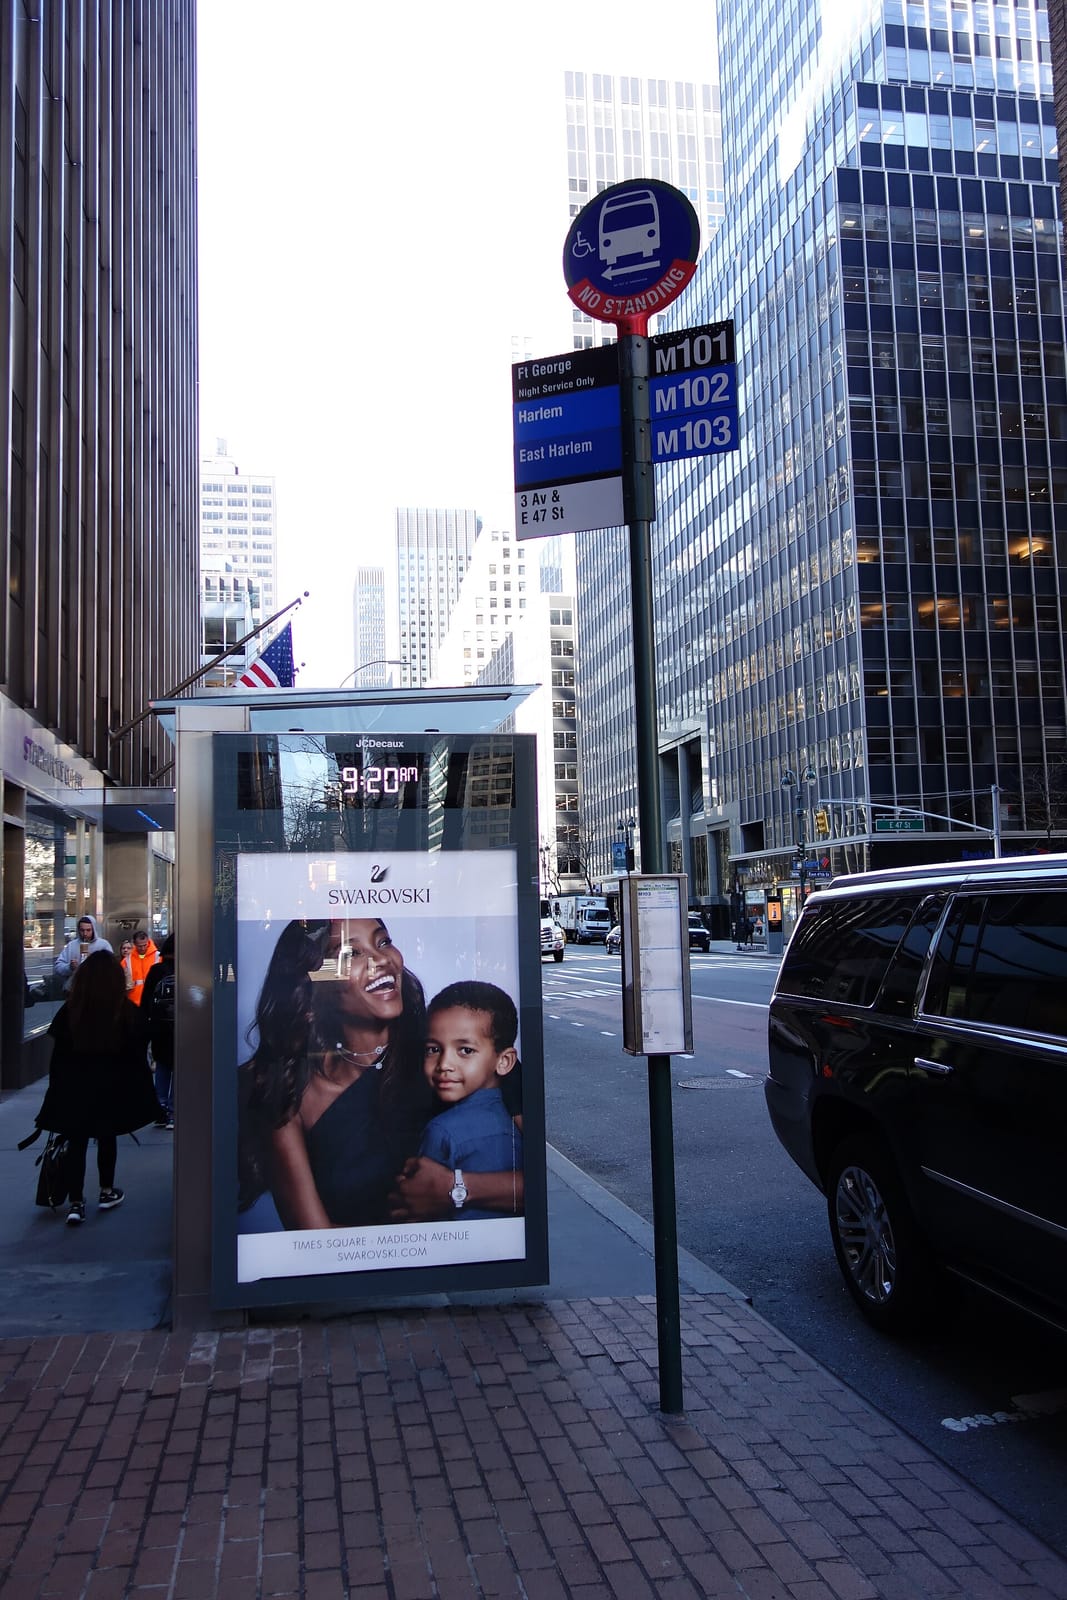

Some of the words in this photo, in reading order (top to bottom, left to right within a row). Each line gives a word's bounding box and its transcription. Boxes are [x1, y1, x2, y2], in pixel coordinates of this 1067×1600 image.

[578, 285, 600, 308] NO
[602, 267, 686, 315] STANDING
[655, 330, 727, 373] M101
[518, 366, 529, 380] Ft
[532, 359, 572, 378] George
[518, 386, 541, 399] Night
[542, 380, 574, 394] Service
[576, 375, 596, 388] Only
[655, 372, 730, 413] M102
[518, 405, 563, 424] Harlem
[657, 415, 732, 456] M103
[519, 450, 545, 463] East
[548, 438, 593, 458] Harlem
[520, 494, 528, 508] 3
[532, 493, 547, 506] Av
[551, 489, 561, 503] &
[521, 511, 529, 525] E
[533, 508, 547, 522] 47
[551, 505, 565, 520] St
[355, 739, 404, 748] JCDecaux
[889, 821, 894, 829] E
[328, 888, 431, 905] SWAROVSKI
[293, 1240, 323, 1251] TIMES
[326, 1236, 367, 1249] SQUARE
[377, 1233, 428, 1245] MADISON
[431, 1231, 470, 1243] AVENUE
[337, 1248, 427, 1262] SWAROVSKI.COM
